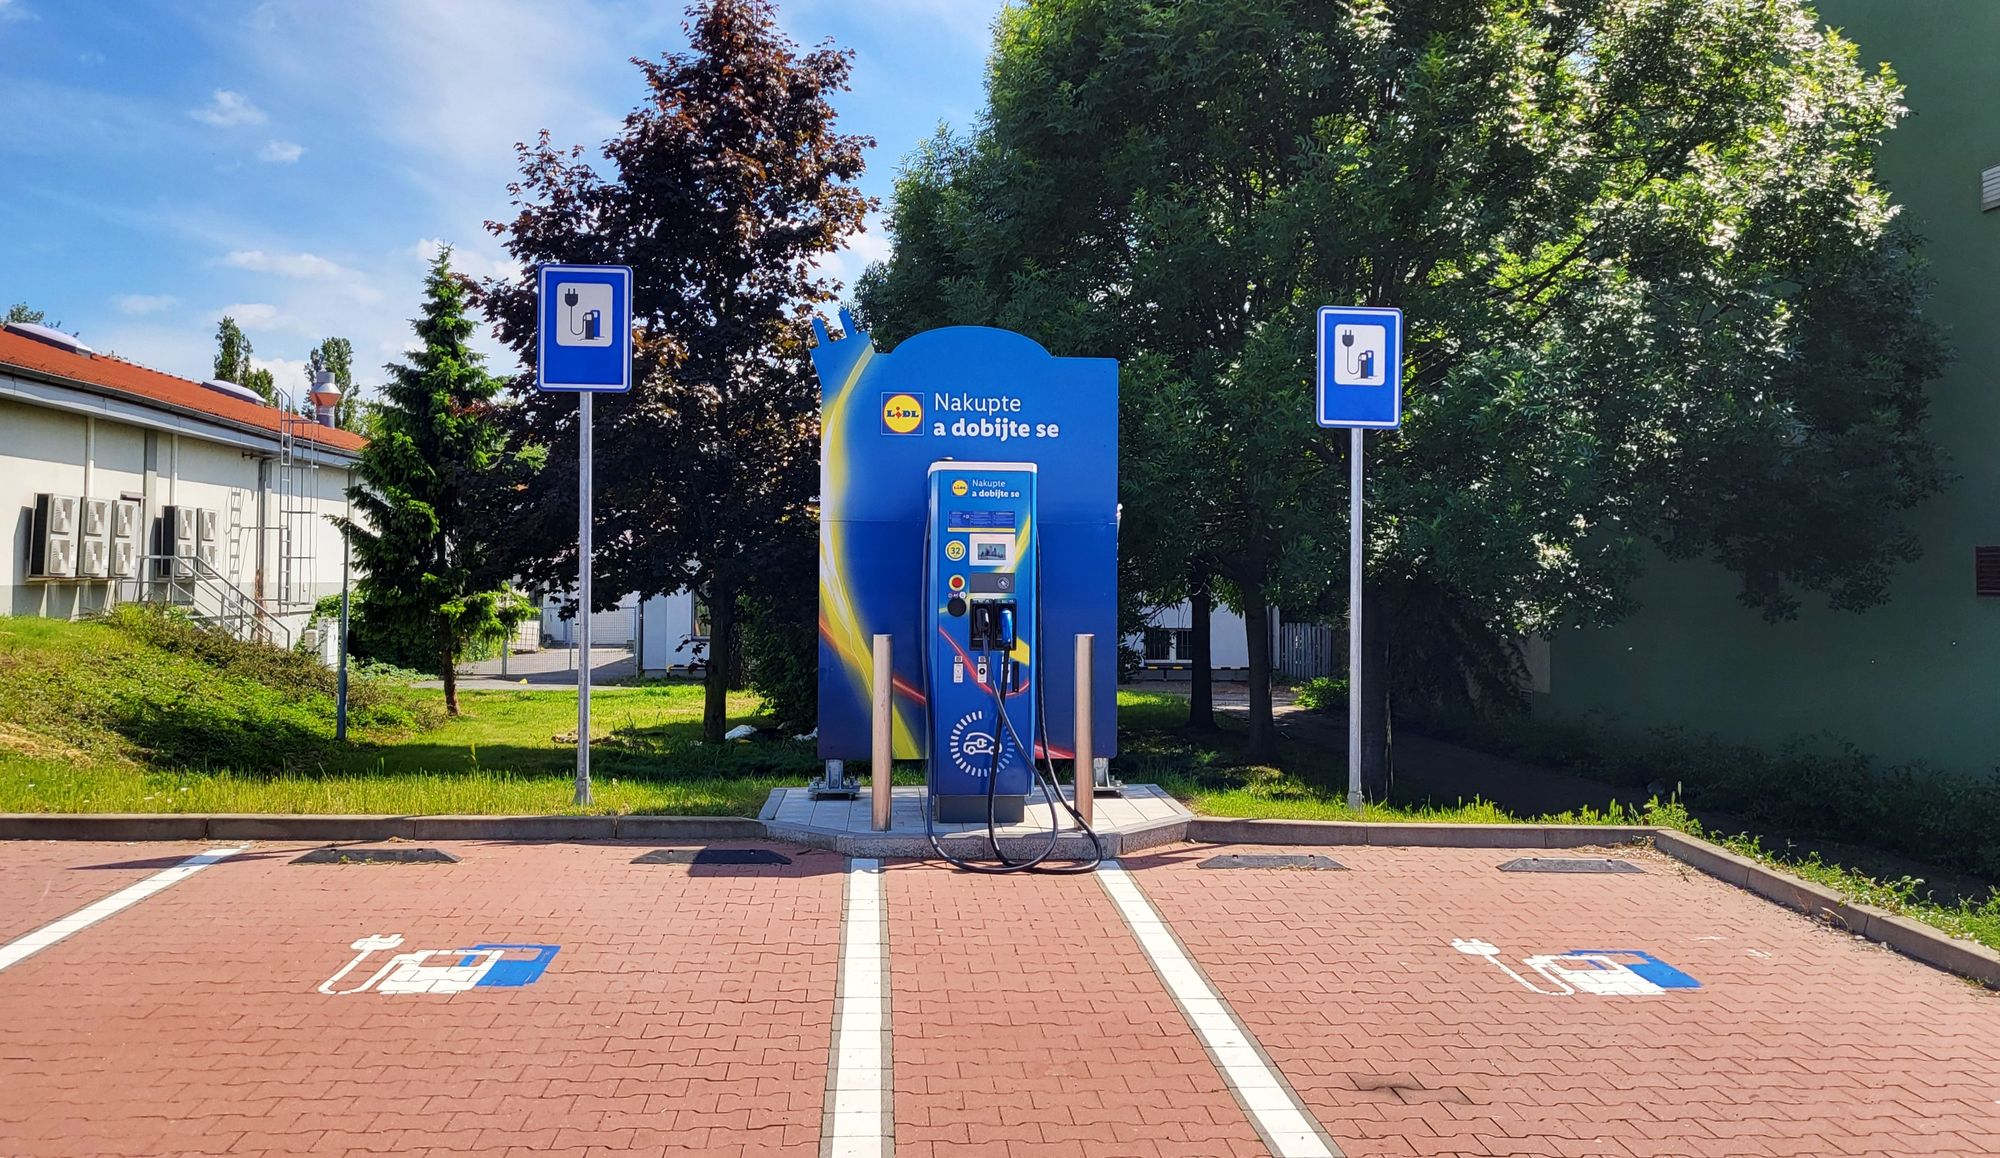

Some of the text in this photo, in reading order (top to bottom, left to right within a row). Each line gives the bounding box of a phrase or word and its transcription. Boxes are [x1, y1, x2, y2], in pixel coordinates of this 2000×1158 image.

[934, 392, 1021, 416] Nakupte
[933, 418, 1059, 442] a dobijte se
[972, 479, 1006, 488] Nakupte
[978, 489, 1009, 499] dobijte
[950, 547, 961, 555] 32
